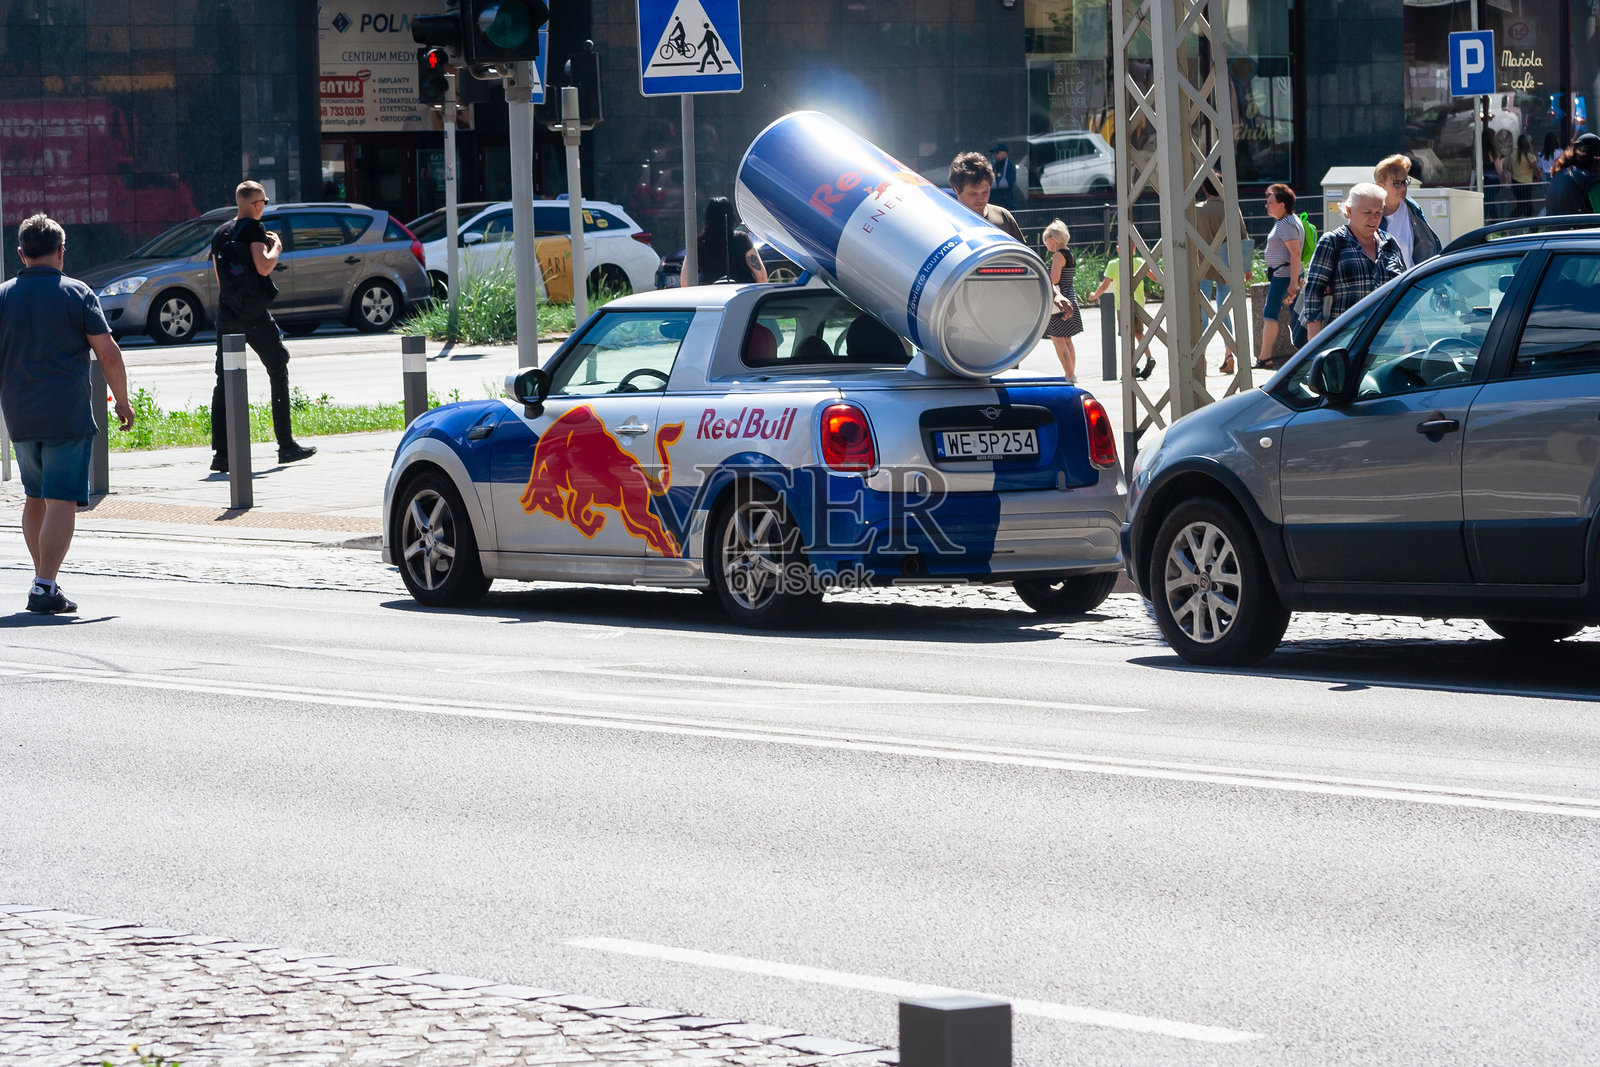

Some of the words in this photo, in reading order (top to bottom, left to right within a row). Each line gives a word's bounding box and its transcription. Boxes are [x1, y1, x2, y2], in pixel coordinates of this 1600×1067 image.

[360, 13, 416, 33] POLM
[342, 51, 387, 62] CENTRUM
[389, 51, 418, 62] MEDY
[1459, 39, 1485, 88] P
[1502, 50, 1543, 67] Mariola
[320, 80, 361, 94] ENTUS
[378, 77, 409, 85] IMPLANTY
[1047, 72, 1084, 95] Latte
[330, 106, 344, 116] 733
[345, 106, 354, 116] 03
[355, 106, 365, 116] 00
[380, 105, 417, 113] ESTETYCZNA
[947, 433, 973, 455] WE
[978, 432, 1034, 454] 5P254
